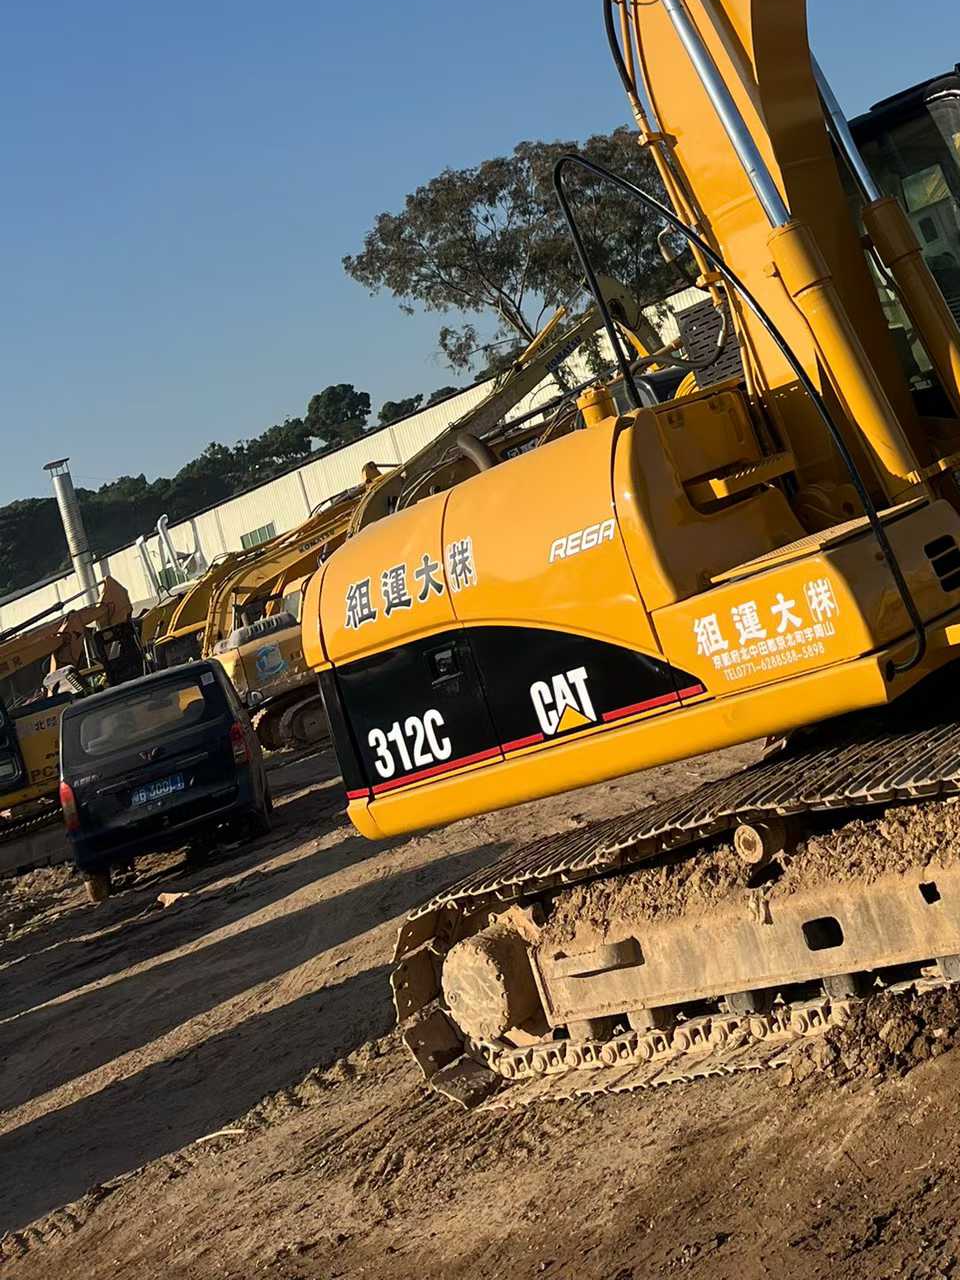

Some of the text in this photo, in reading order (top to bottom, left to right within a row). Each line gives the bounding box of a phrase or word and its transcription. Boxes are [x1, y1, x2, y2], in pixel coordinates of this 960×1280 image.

[548, 518, 617, 563] REGA
[530, 666, 598, 736] CAT
[367, 708, 452, 779] 312C
